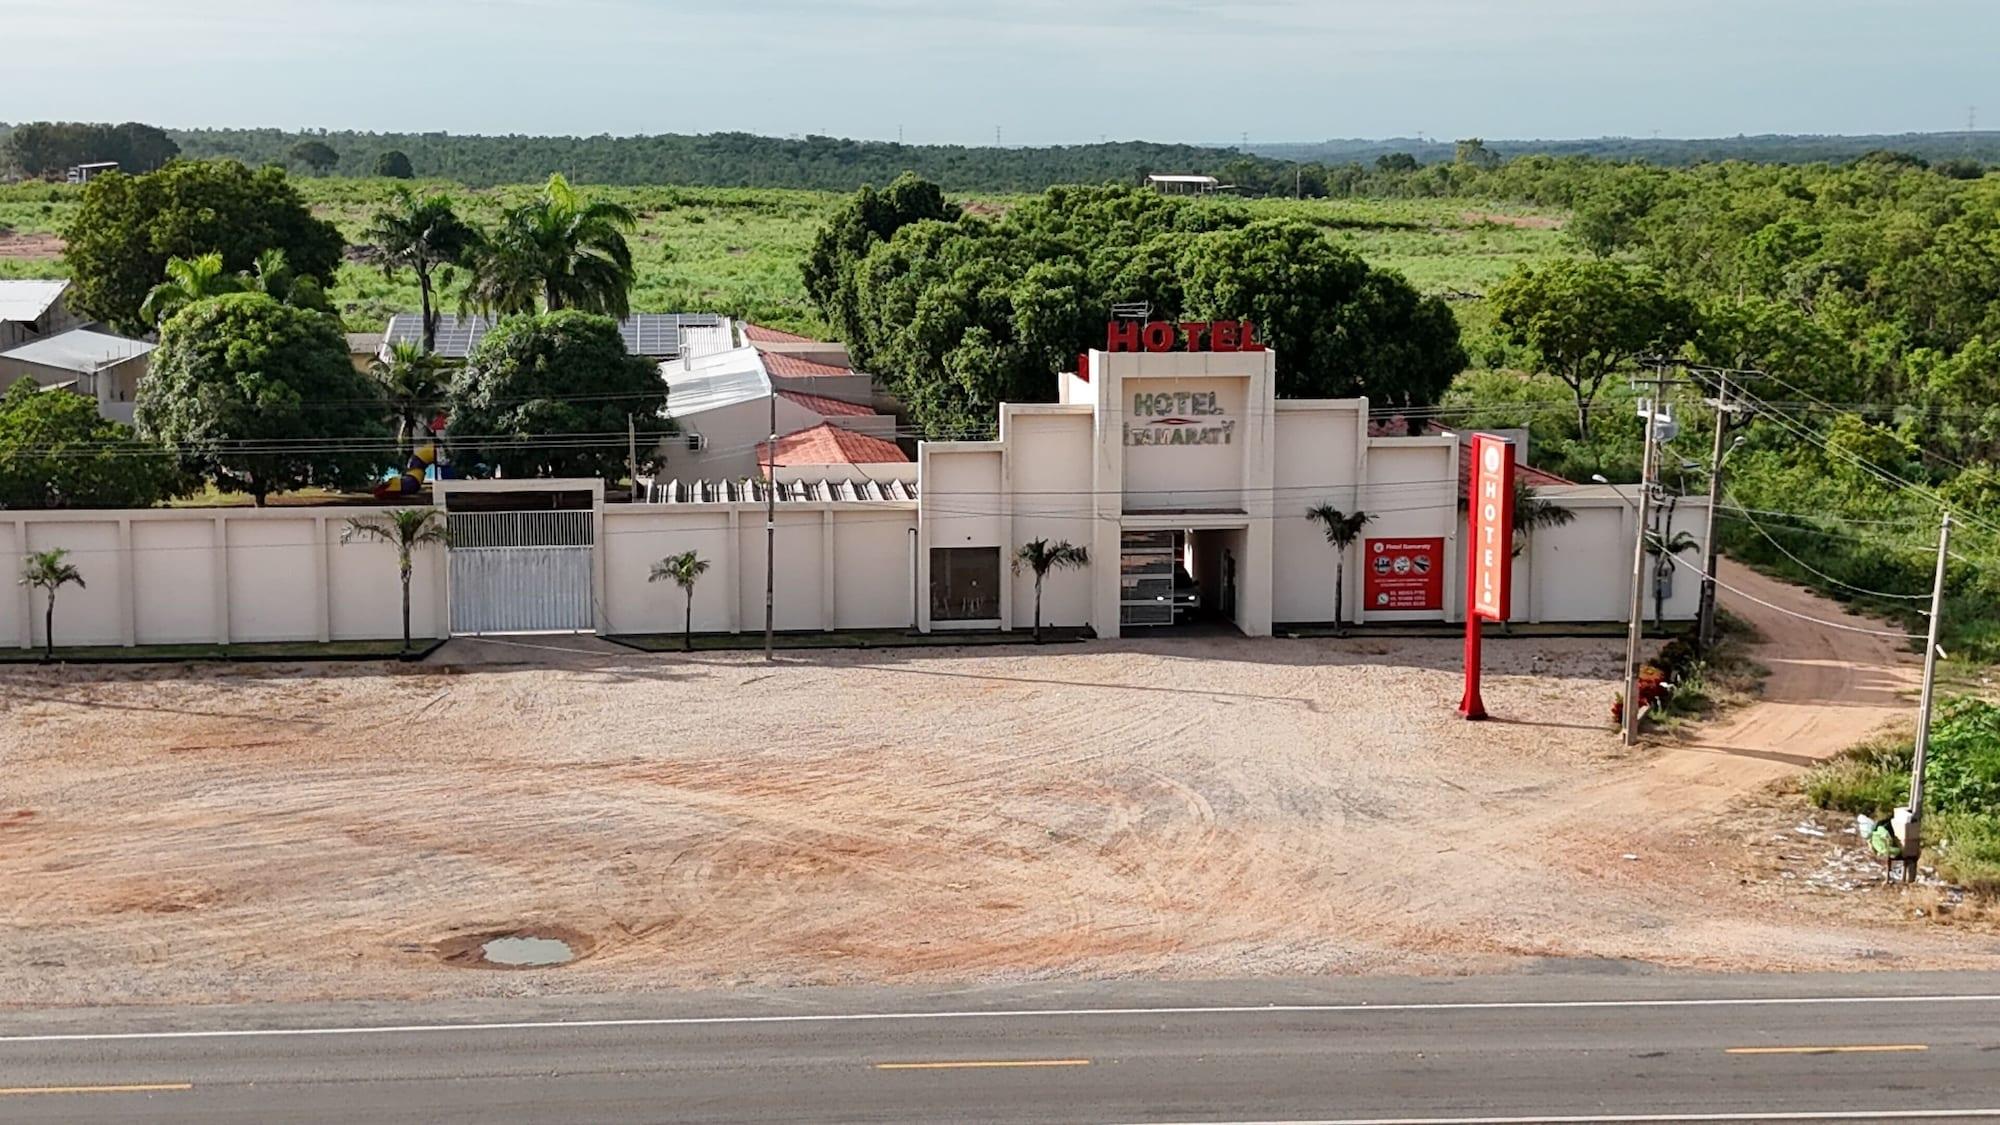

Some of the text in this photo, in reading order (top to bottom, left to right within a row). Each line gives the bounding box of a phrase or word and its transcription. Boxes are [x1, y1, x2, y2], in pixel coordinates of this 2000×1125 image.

[1107, 321, 1266, 353] HOTEL
[1134, 391, 1224, 416] HOTEL
[1122, 420, 1235, 446] ITAMARATY
[1484, 481, 1497, 590] HOTEL
